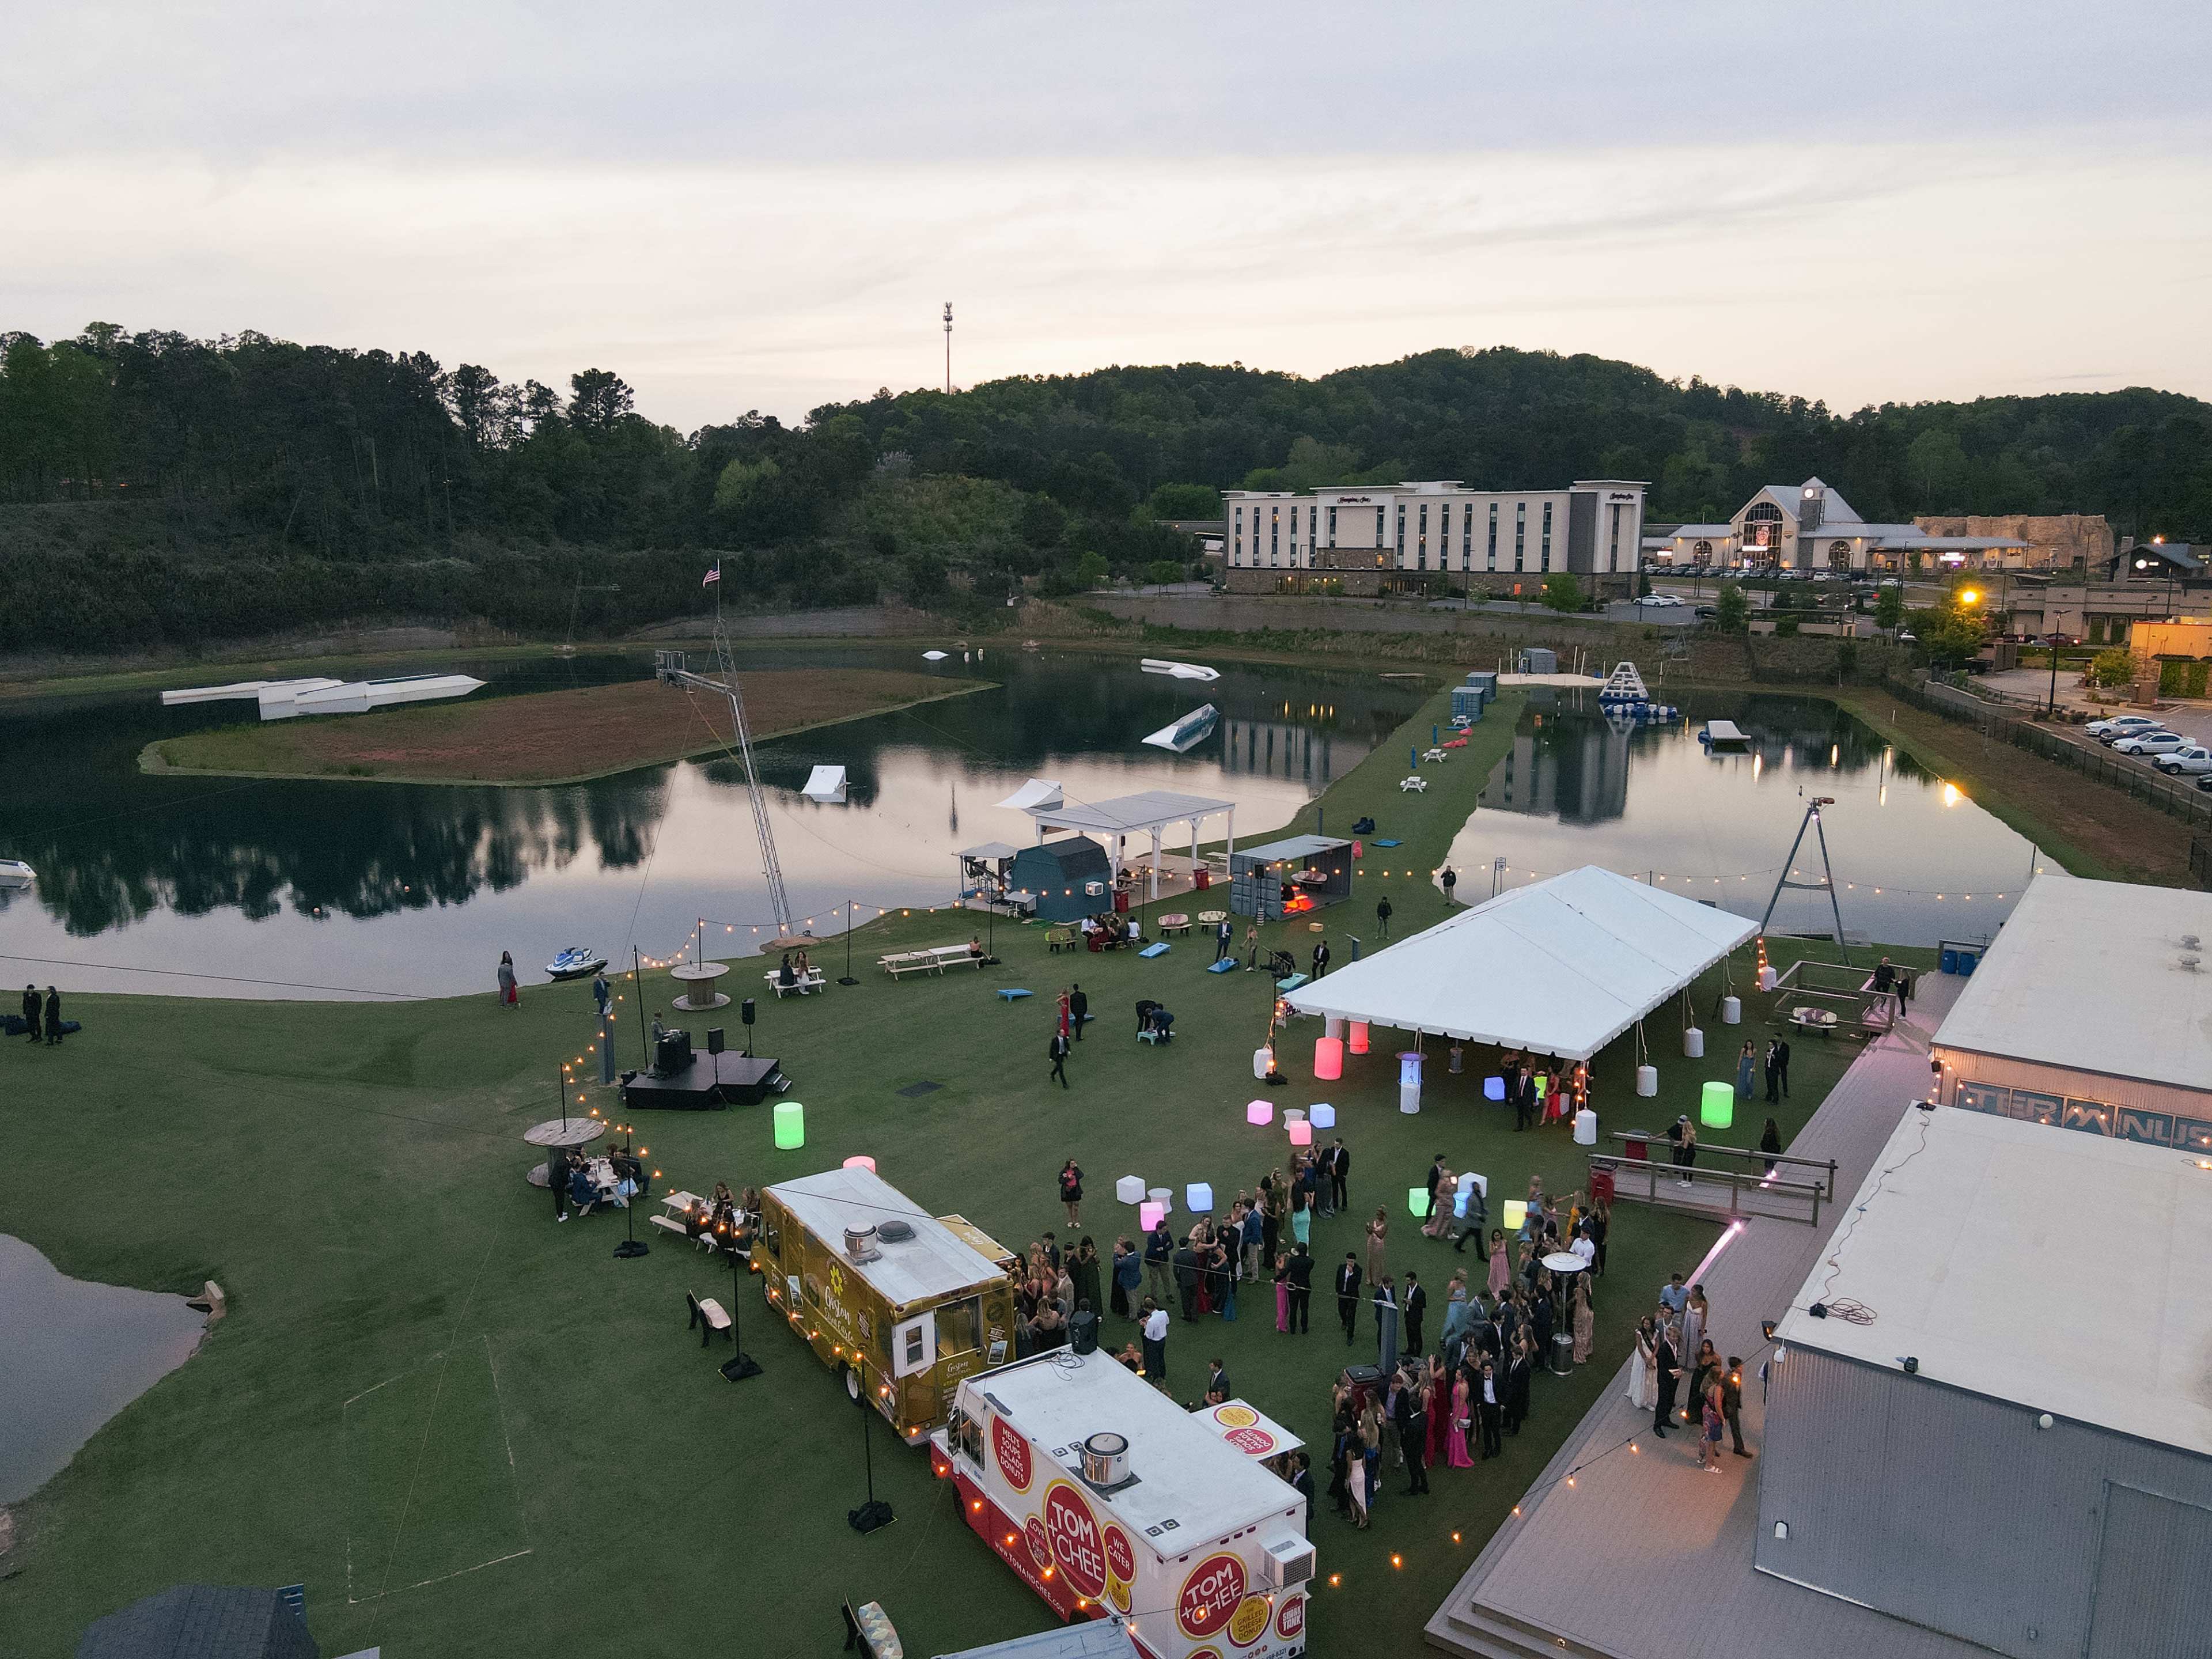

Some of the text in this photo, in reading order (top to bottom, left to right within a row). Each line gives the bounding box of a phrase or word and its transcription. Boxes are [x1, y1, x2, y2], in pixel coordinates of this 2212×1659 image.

[1002, 1427, 1020, 1448] MELTS
[1238, 1432, 1264, 1449] SALADS
[1244, 1429, 1271, 1447] DONUTS
[1001, 1446, 1024, 1472] SALADS
[1002, 1437, 1021, 1460] SOUPS
[1000, 1456, 1024, 1483] DONUTS
[1029, 1519, 1045, 1540] LOVE
[1051, 1501, 1094, 1548] TOM
[1113, 1536, 1124, 1554] WE
[1108, 1545, 1130, 1571] CATER
[1186, 1563, 1234, 1604] TOM
[1237, 1609, 1264, 1625] GRILLED
[1238, 1616, 1263, 1632] CHEESE
[1282, 1615, 1302, 1631] TANK
[1238, 1624, 1262, 1639] DONUT
